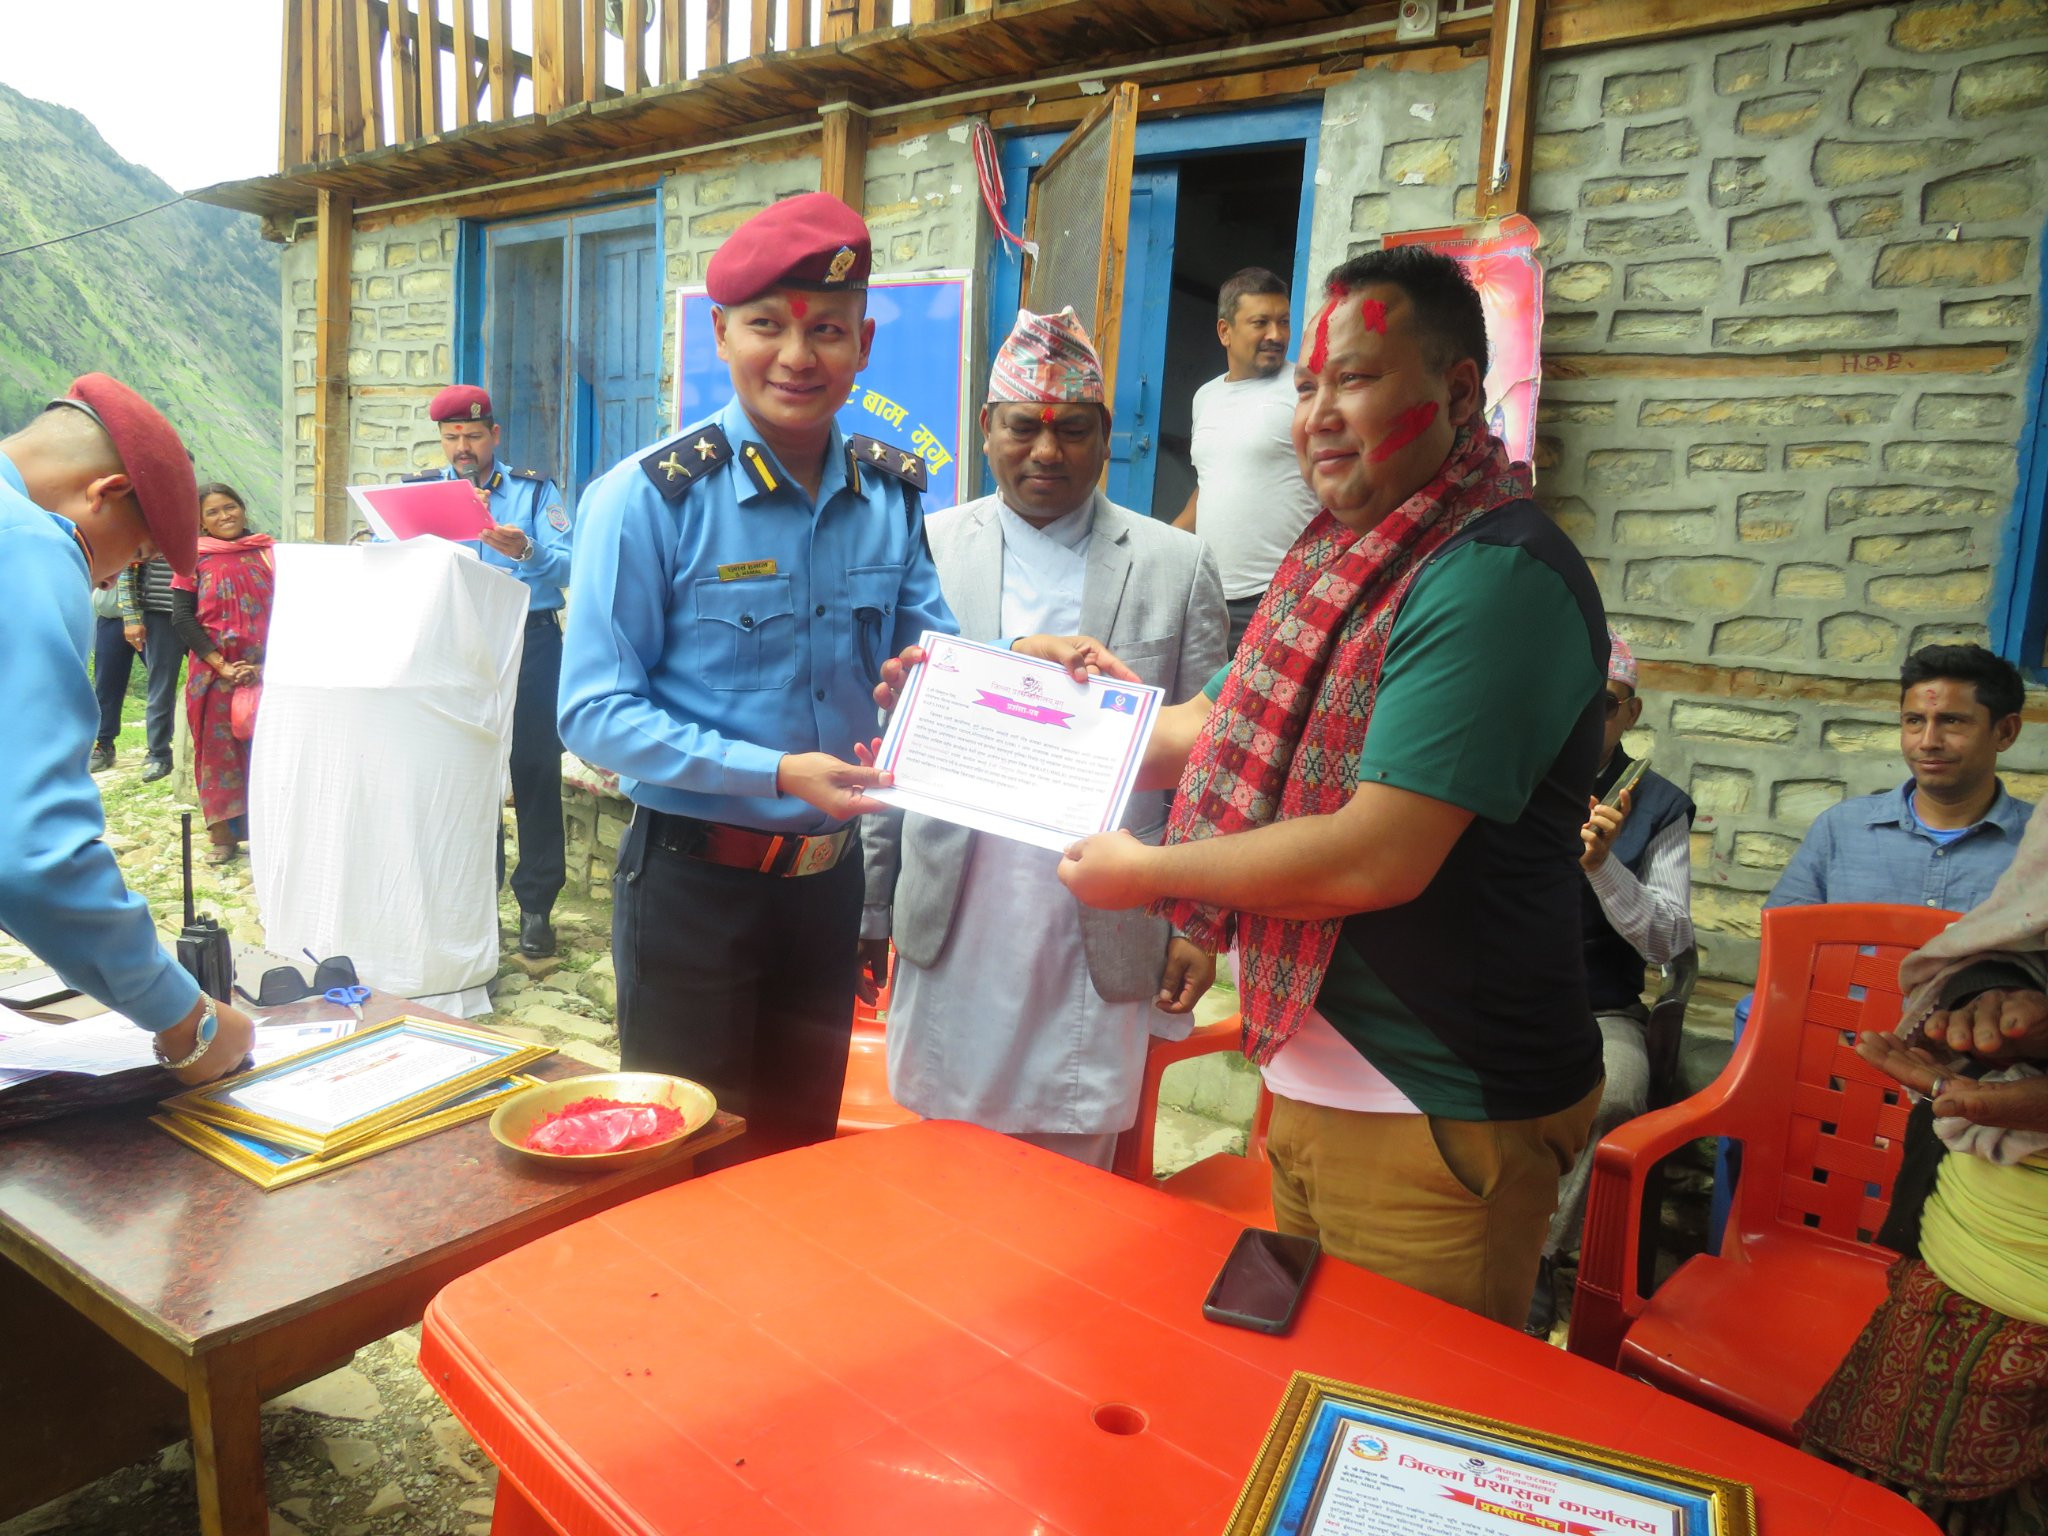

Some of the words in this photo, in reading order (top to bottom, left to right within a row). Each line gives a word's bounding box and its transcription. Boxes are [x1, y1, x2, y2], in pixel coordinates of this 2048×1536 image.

[862, 389, 909, 432] बाम,
[1397, 1454, 1467, 1483] जिल्ला
[1473, 1476, 1551, 1506] प्रशासन
[1559, 1498, 1659, 1535] कार्यालय
[1478, 1500, 1561, 1533] प्रशंसा-पत्र
